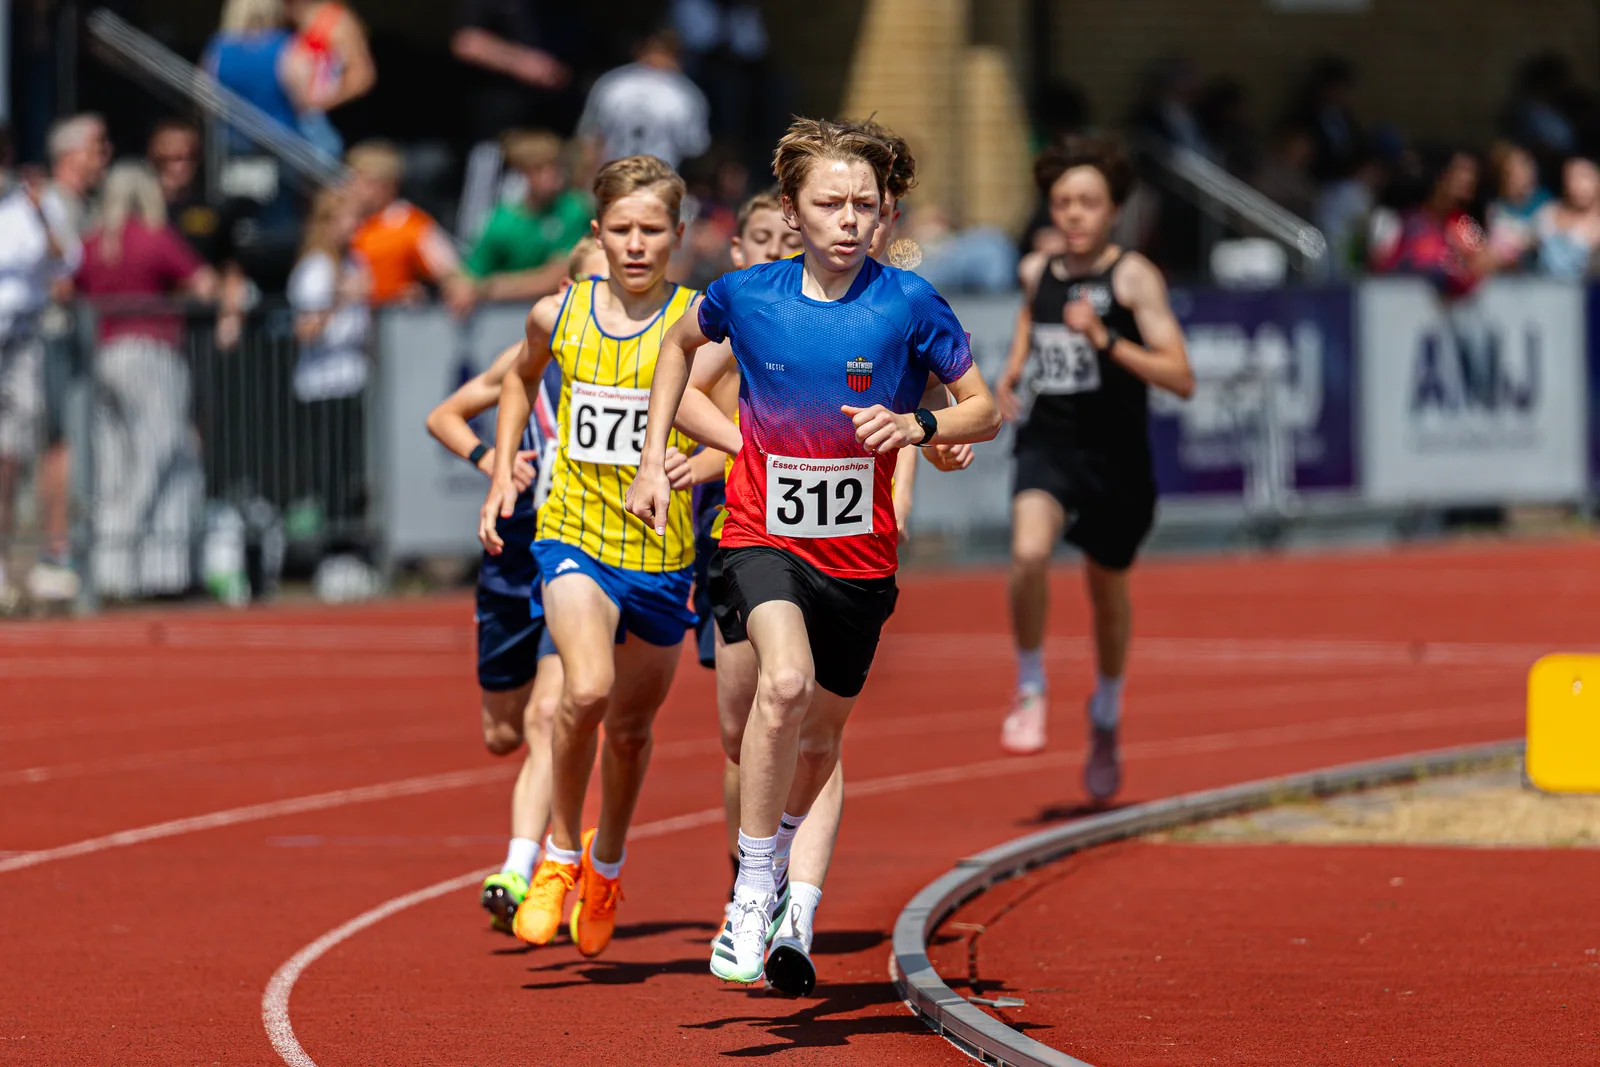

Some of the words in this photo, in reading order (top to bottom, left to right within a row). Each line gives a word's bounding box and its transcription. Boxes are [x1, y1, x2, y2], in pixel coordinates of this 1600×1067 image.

[765, 362, 785, 371] TACTIC
[576, 404, 649, 453] 675
[772, 460, 798, 471] Essex
[800, 462, 869, 474] Championships
[776, 476, 863, 526] 312
